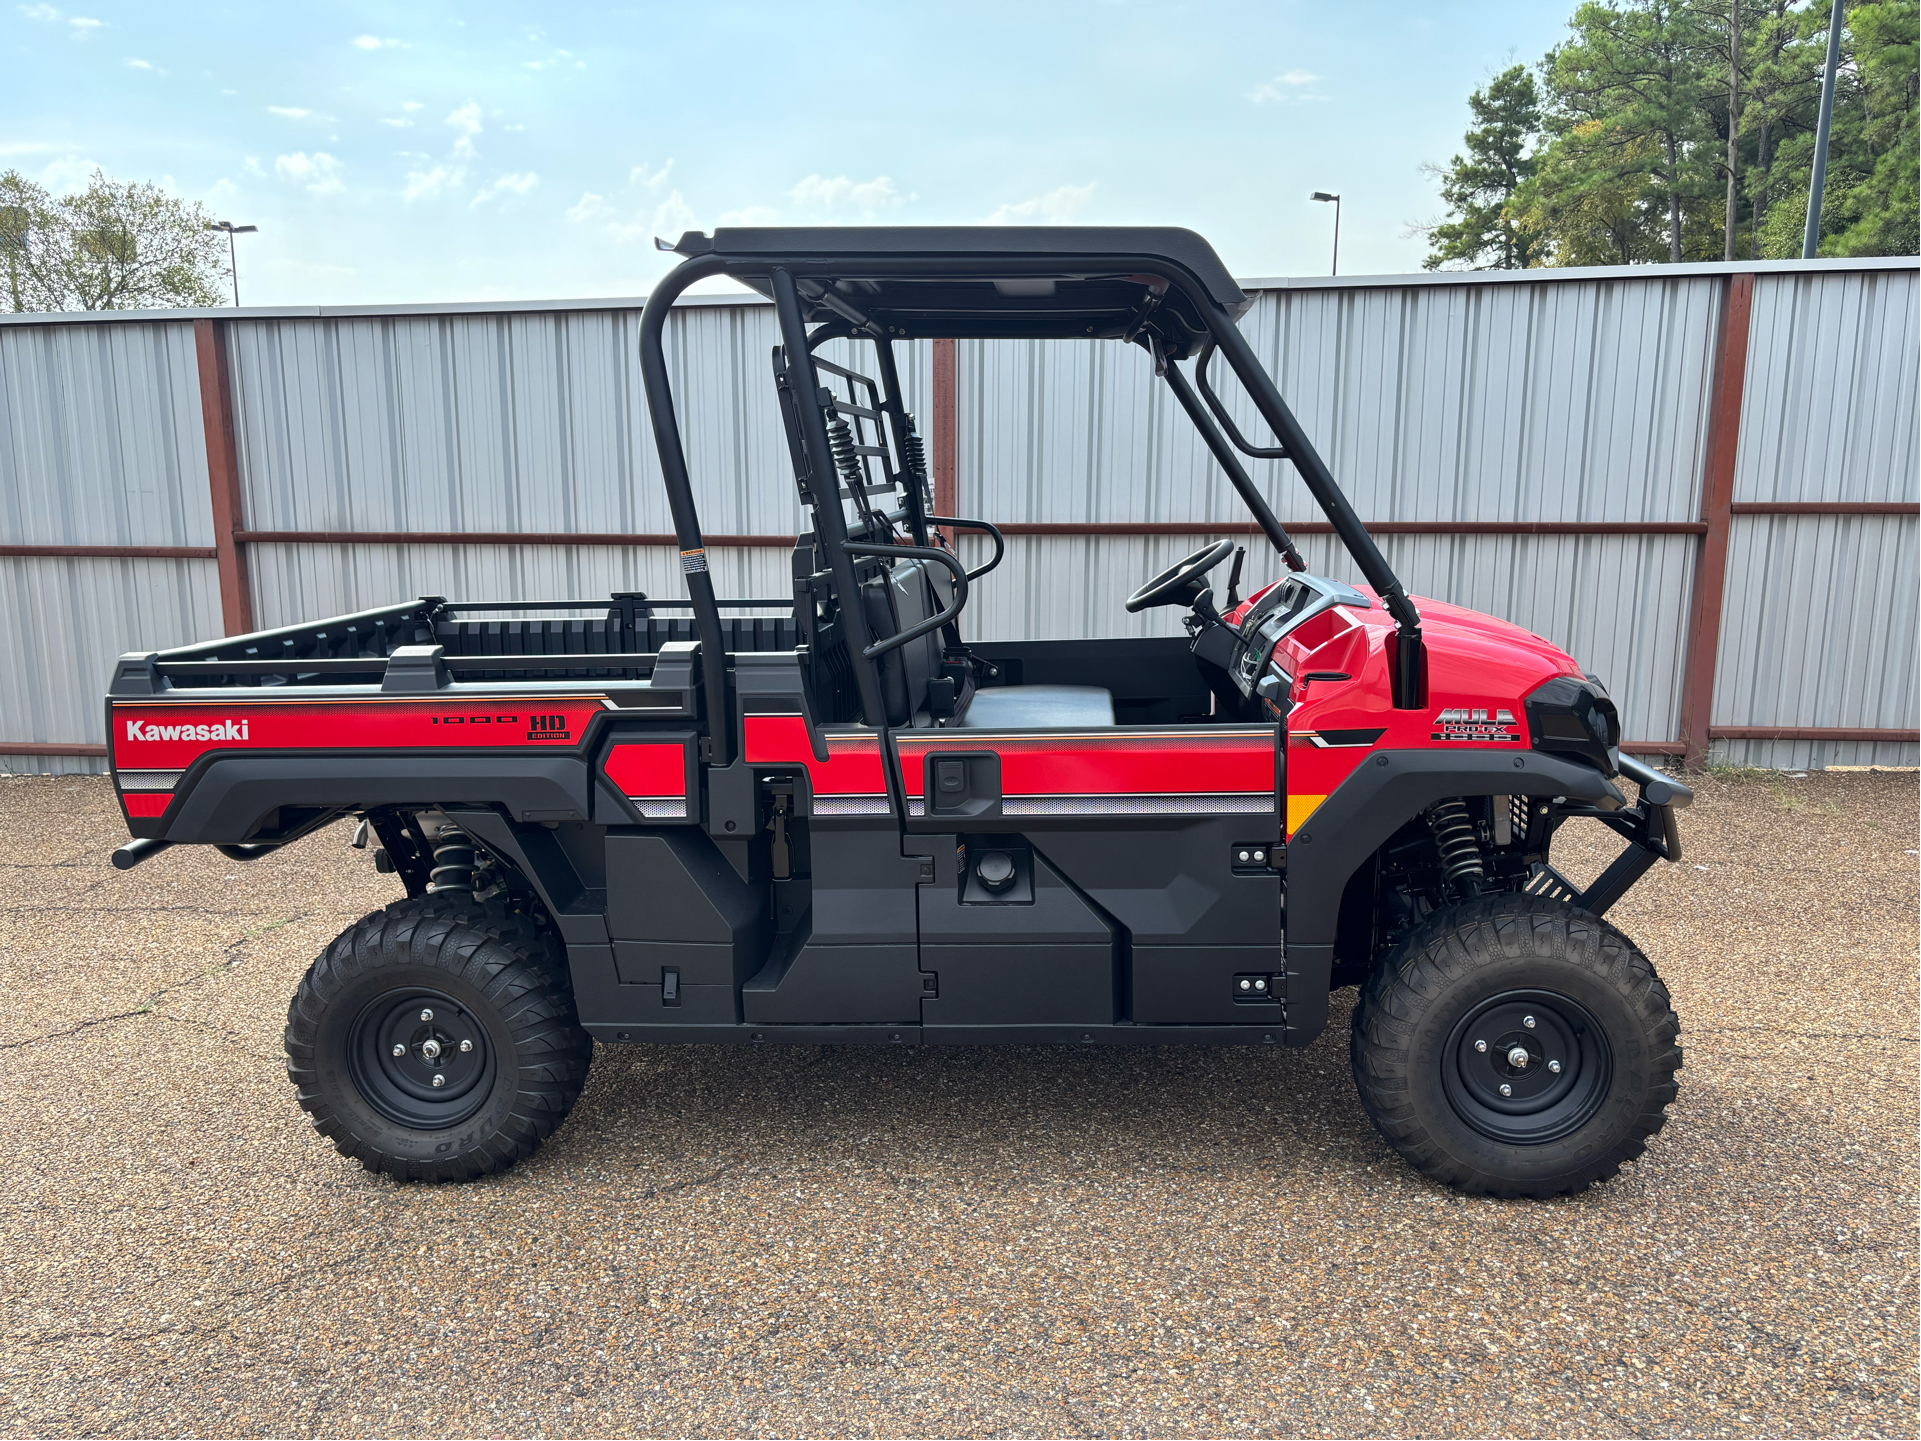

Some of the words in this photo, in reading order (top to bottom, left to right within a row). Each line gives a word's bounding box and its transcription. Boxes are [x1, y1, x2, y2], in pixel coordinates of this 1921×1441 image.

[431, 716, 518, 725] 1000
[530, 715, 566, 731] HD
[1433, 709, 1518, 725] MULE
[126, 720, 249, 741] Kawasaki
[435, 1097, 507, 1155] DURO
[1571, 1070, 1644, 1163] DURO
